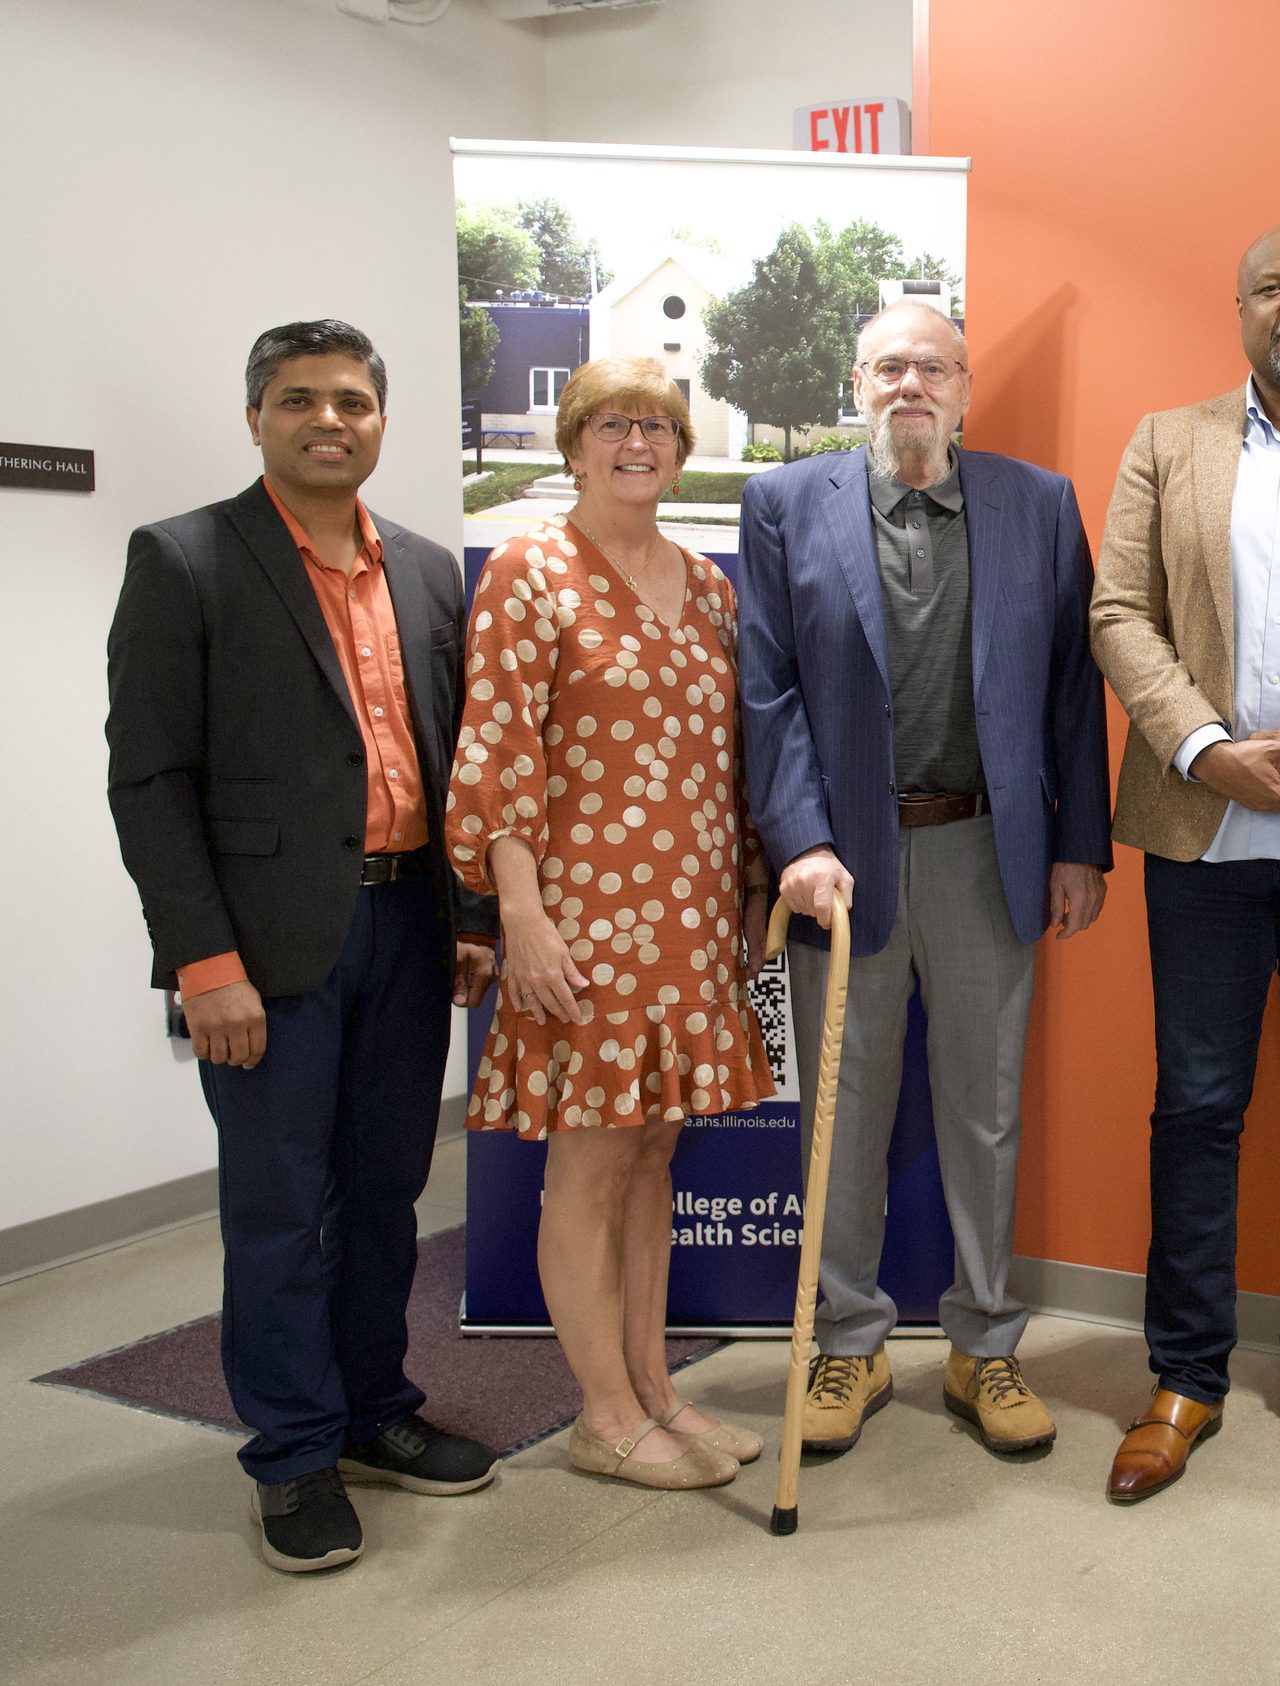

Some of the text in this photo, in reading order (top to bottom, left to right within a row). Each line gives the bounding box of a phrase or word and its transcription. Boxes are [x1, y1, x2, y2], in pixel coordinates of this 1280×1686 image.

[810, 102, 884, 154] EXIT
[56, 461, 87, 474] HALL
[672, 1191, 806, 1221] llege of A
